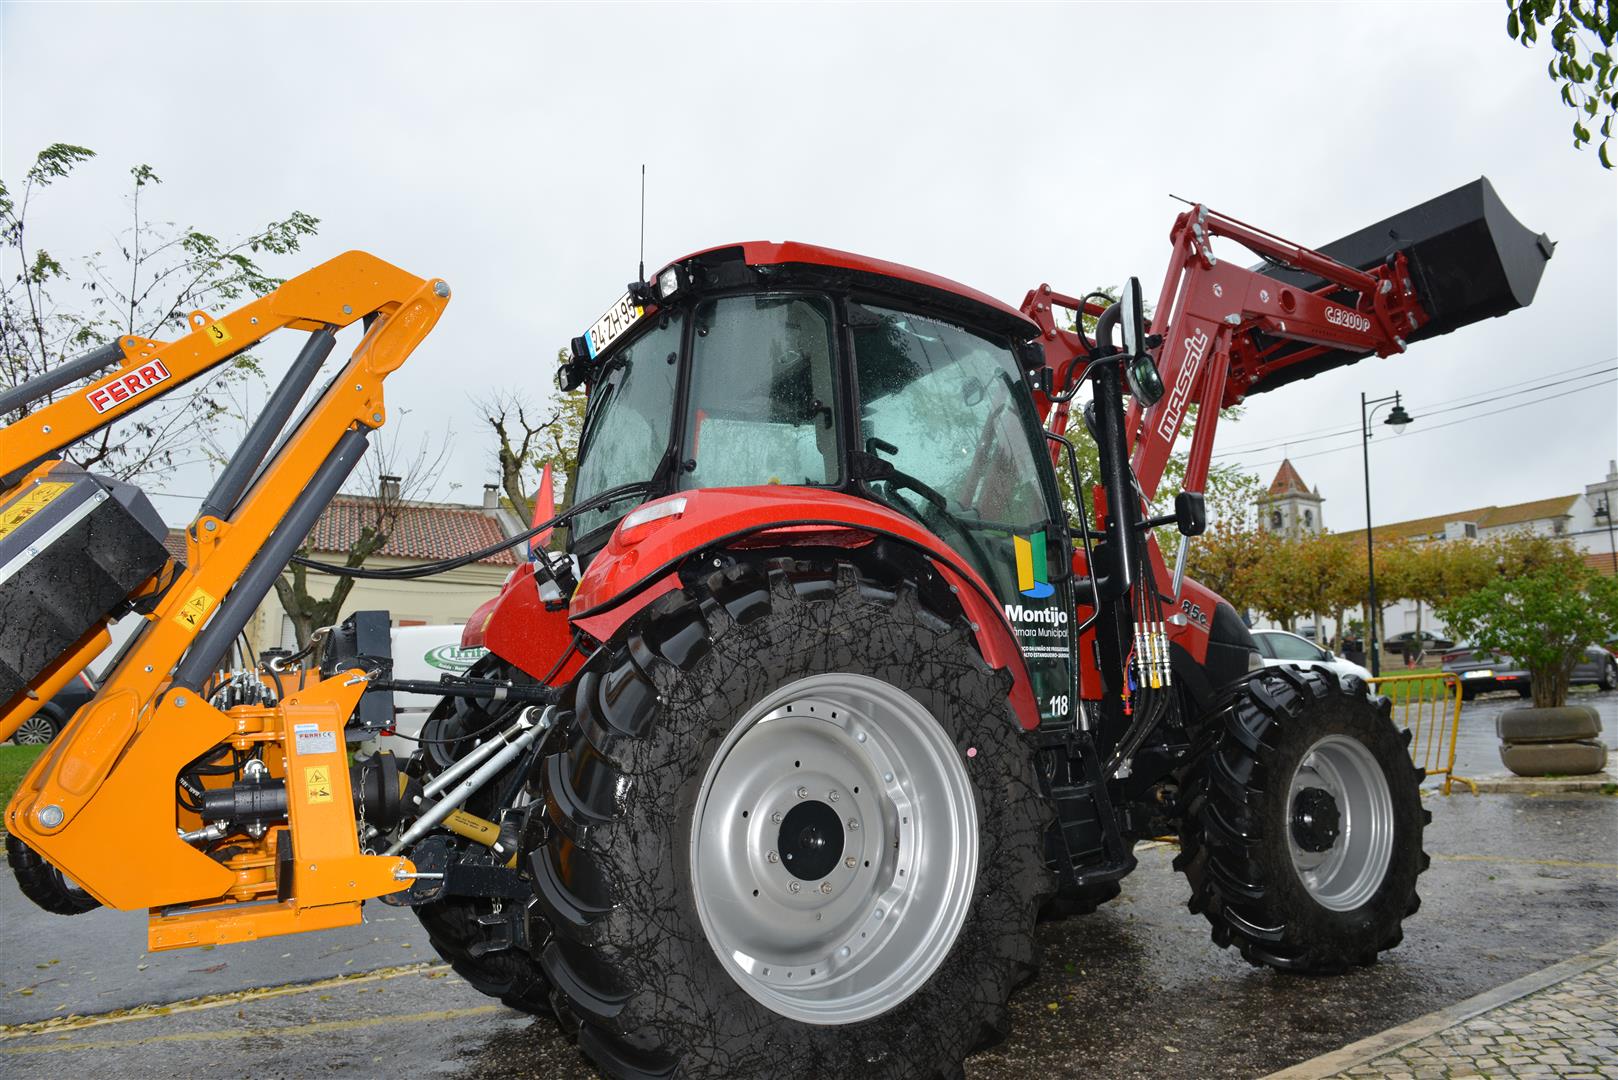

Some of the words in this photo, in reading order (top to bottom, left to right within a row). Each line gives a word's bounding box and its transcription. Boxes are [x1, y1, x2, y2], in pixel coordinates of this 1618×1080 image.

[89, 361, 168, 411] FERRI
[1005, 604, 1068, 626] Montijo
[1038, 628, 1068, 639] Municipal
[1050, 695, 1068, 716] 118
